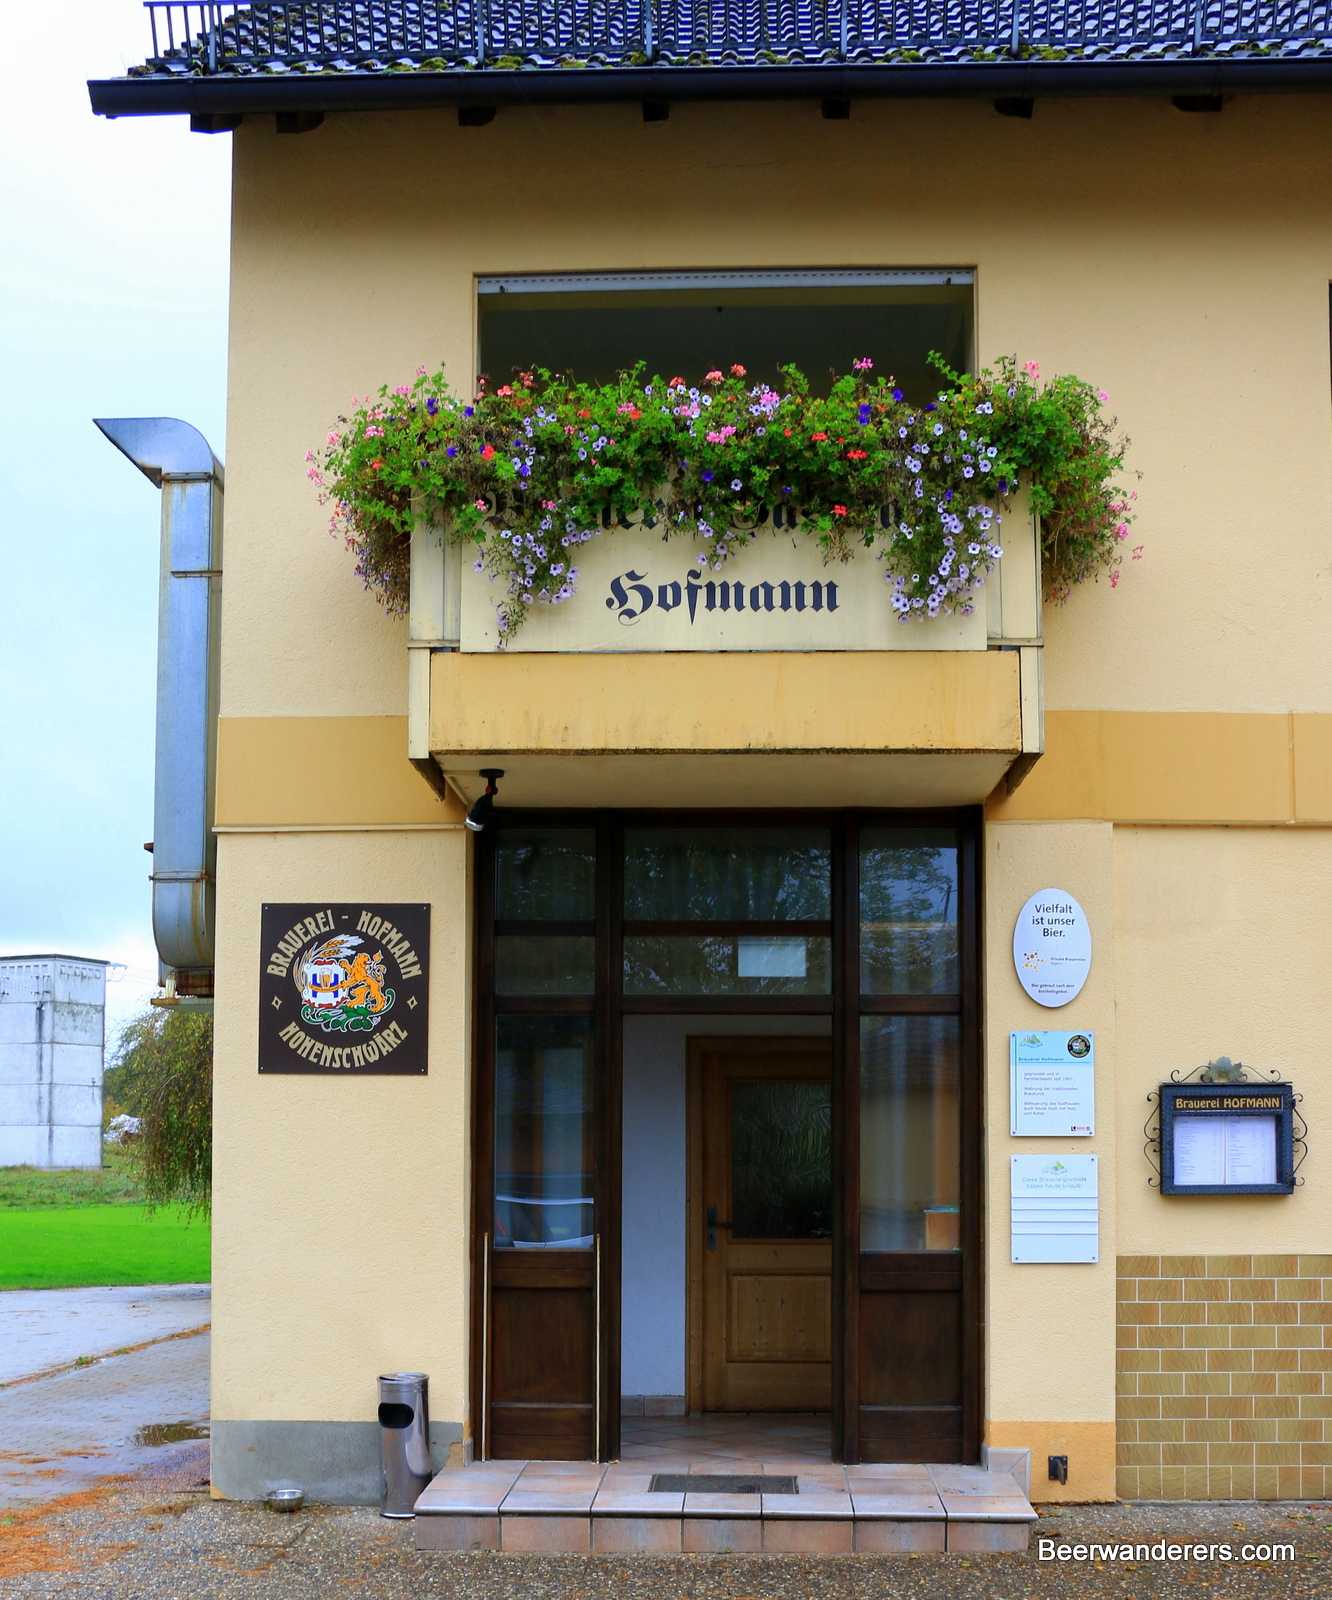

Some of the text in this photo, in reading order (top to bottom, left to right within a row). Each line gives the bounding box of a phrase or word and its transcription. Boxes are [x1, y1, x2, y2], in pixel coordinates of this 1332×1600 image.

[606, 569, 840, 626] Hofmann
[1035, 904, 1072, 914] Vielfalt
[1032, 916, 1076, 925] ist unser
[1043, 928, 1066, 937] Bier.
[266, 910, 336, 978] BRAUEREI
[356, 910, 422, 980] HOFMANN
[278, 1020, 408, 1068] HOHENSCHWÄRZ
[1176, 1098, 1280, 1109] Brauerei HOFMANN
